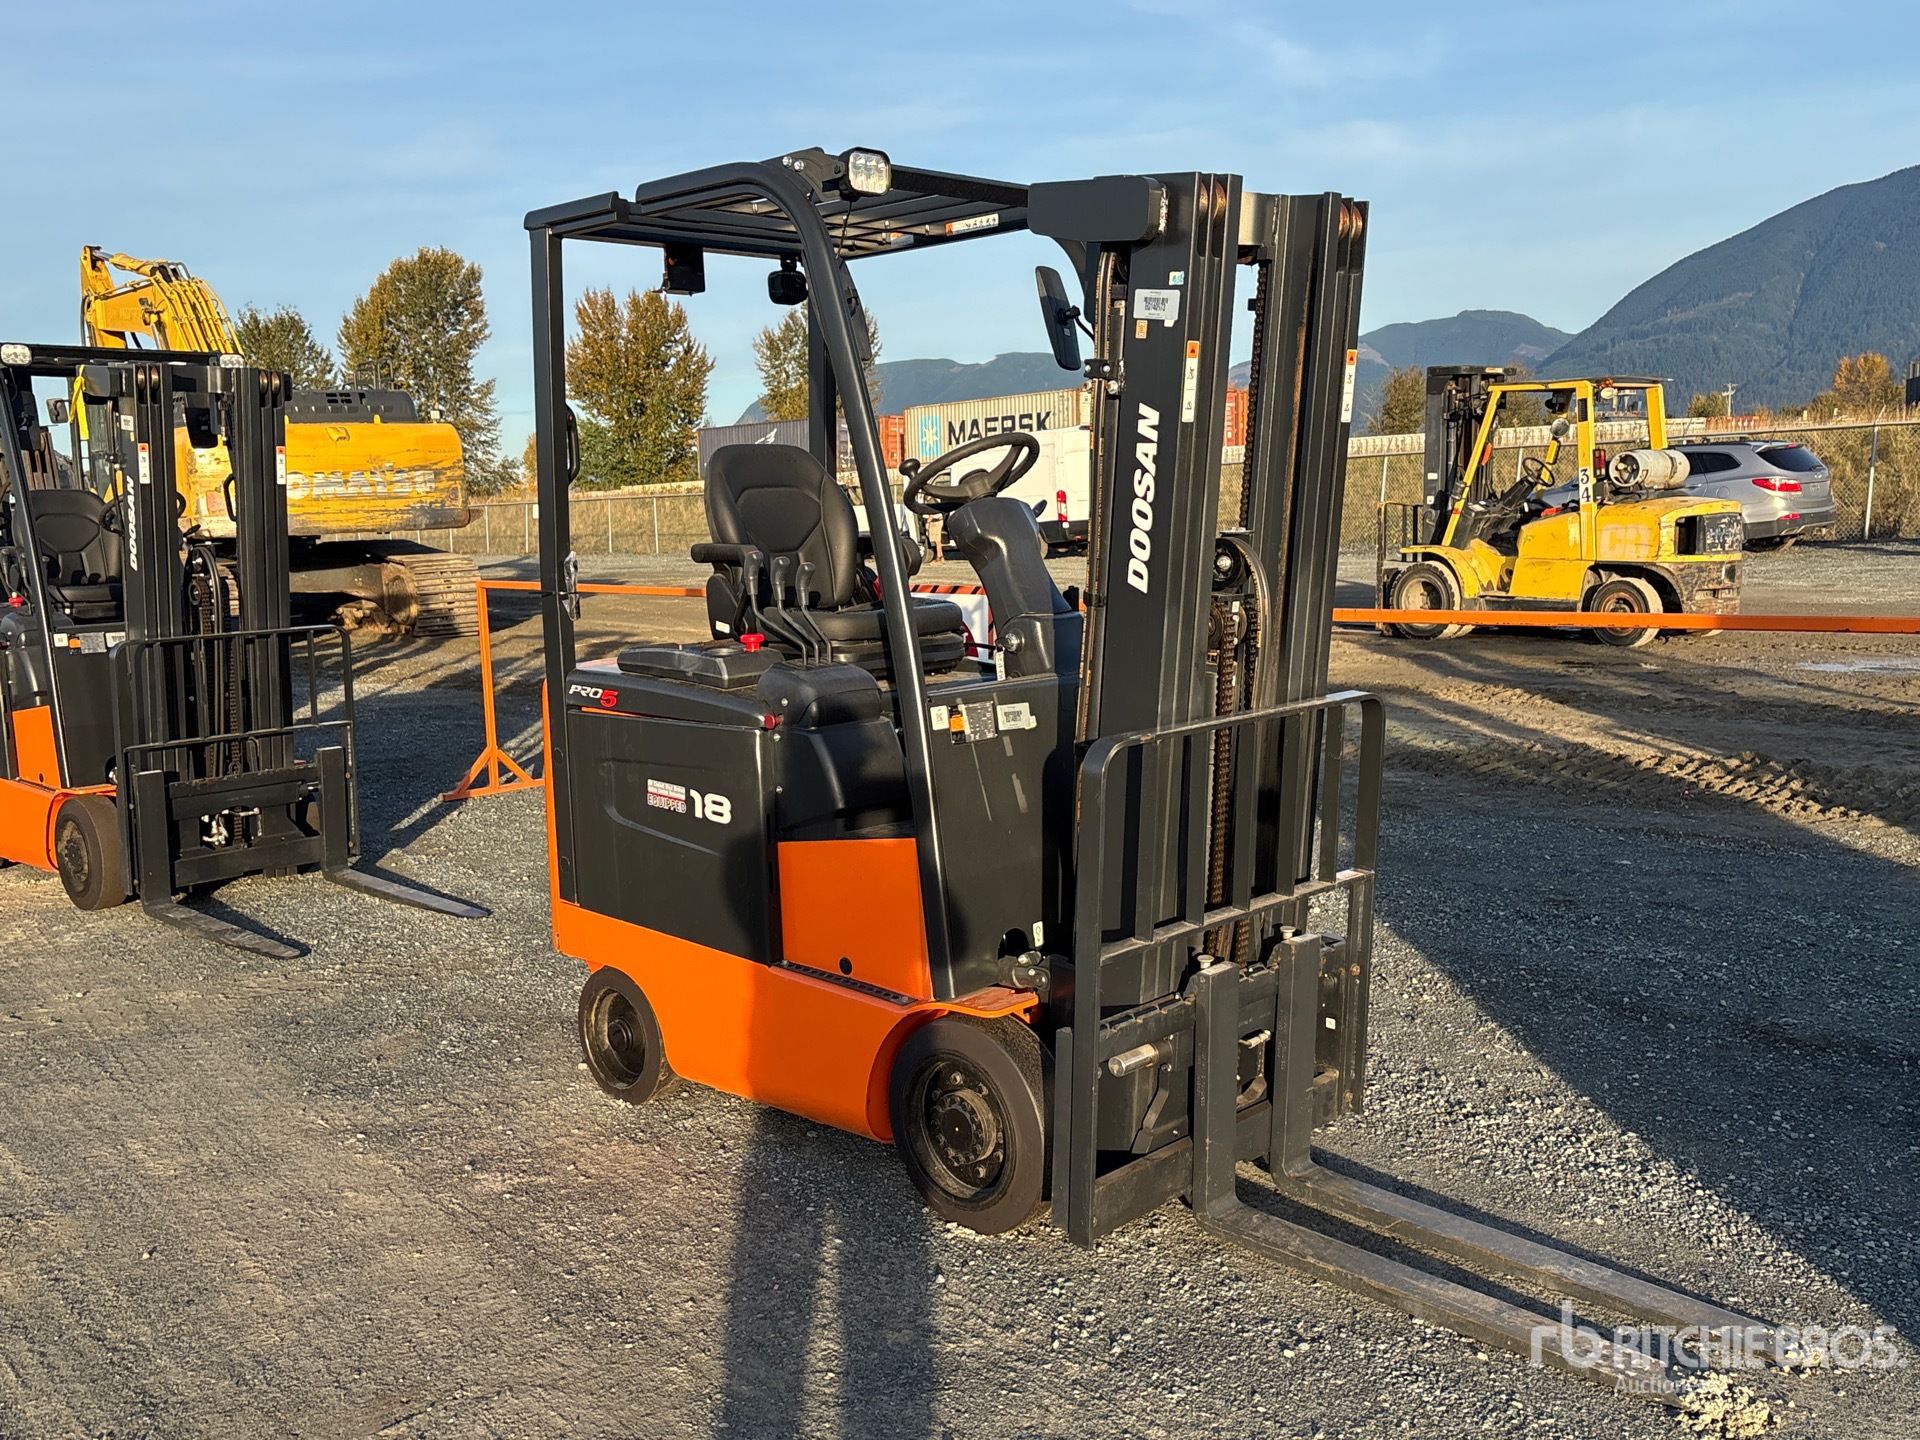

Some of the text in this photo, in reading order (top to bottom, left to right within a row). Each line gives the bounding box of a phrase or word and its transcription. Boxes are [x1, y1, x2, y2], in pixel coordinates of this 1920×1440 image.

[947, 411, 1051, 445] MAERSK
[287, 470, 436, 500] OMATSU
[1127, 402, 1160, 594] DOOSAN
[124, 474, 136, 571] DOOSAN
[647, 793, 687, 814] EQUIPPED
[689, 788, 732, 825] 18
